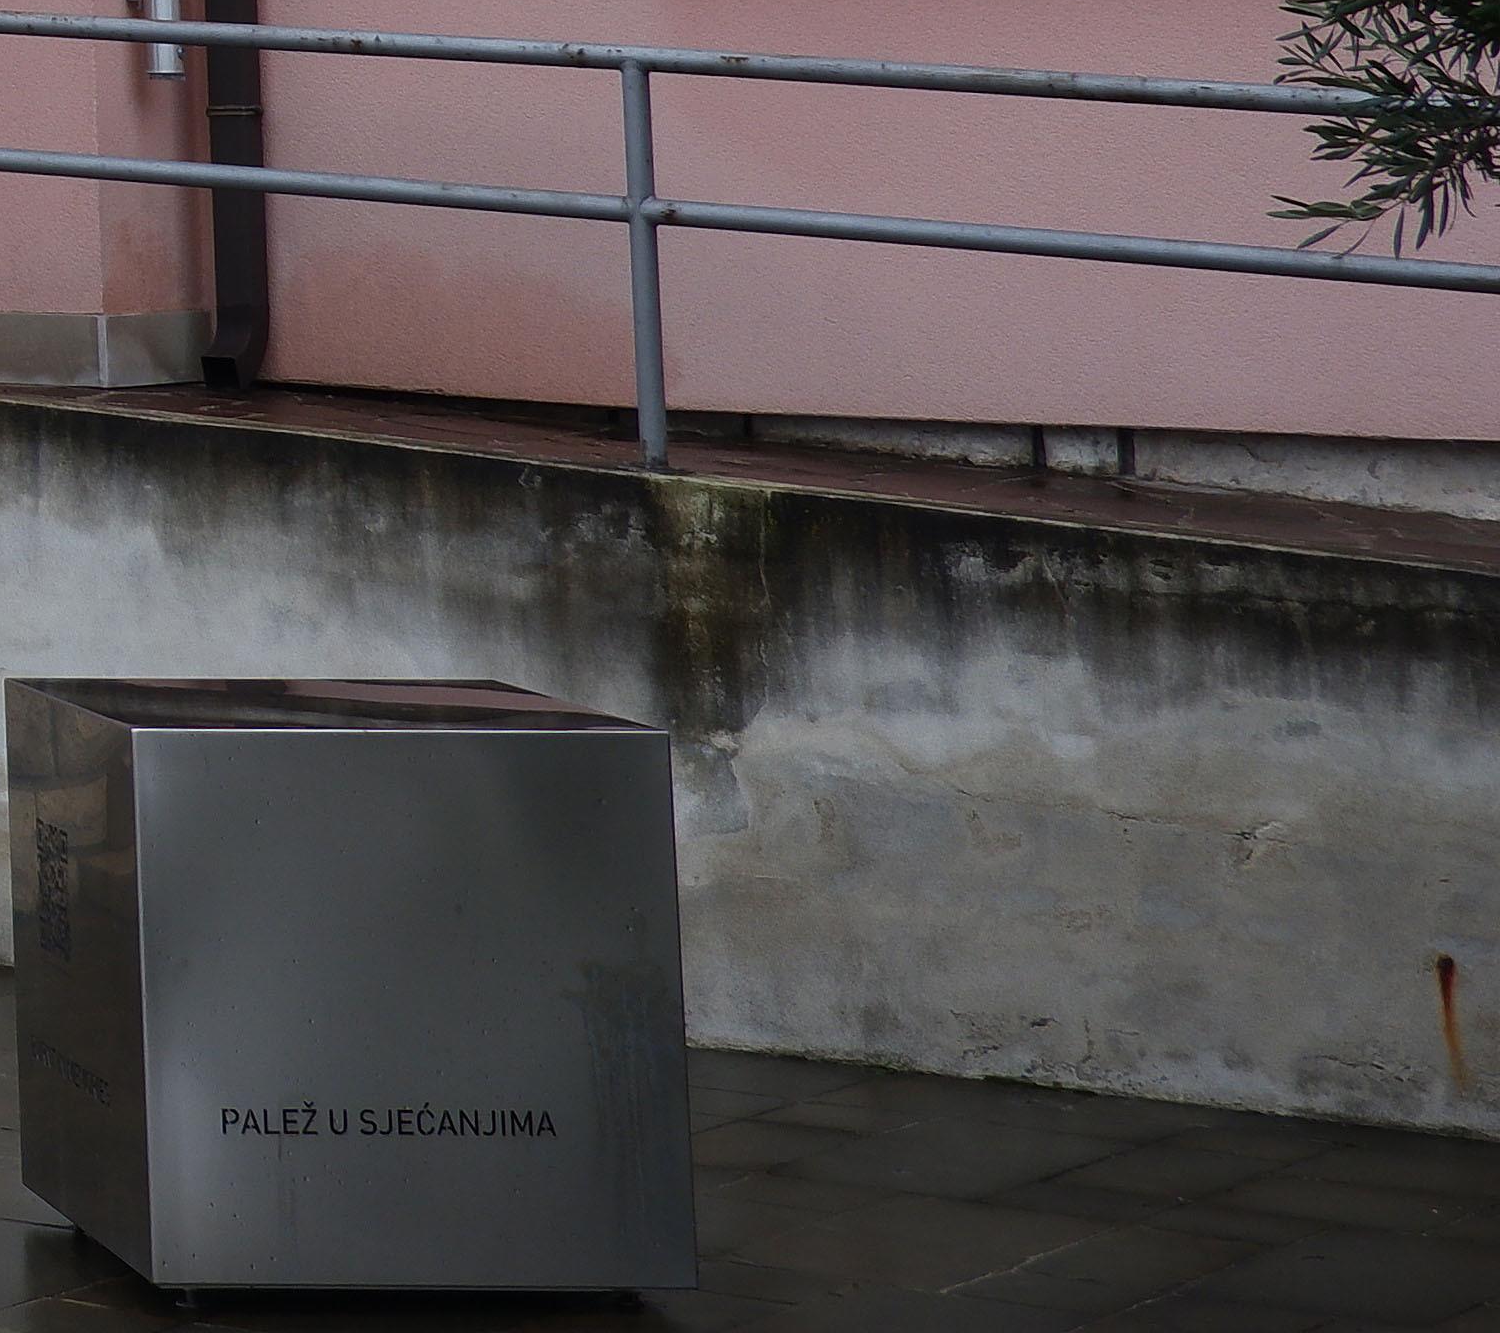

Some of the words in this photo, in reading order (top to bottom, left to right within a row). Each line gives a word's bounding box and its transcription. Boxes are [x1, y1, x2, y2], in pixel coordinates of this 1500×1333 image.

[220, 1101, 318, 1136] PALEŽ
[329, 1108, 349, 1136] U
[359, 1101, 558, 1137] SJEĆANJIMA
